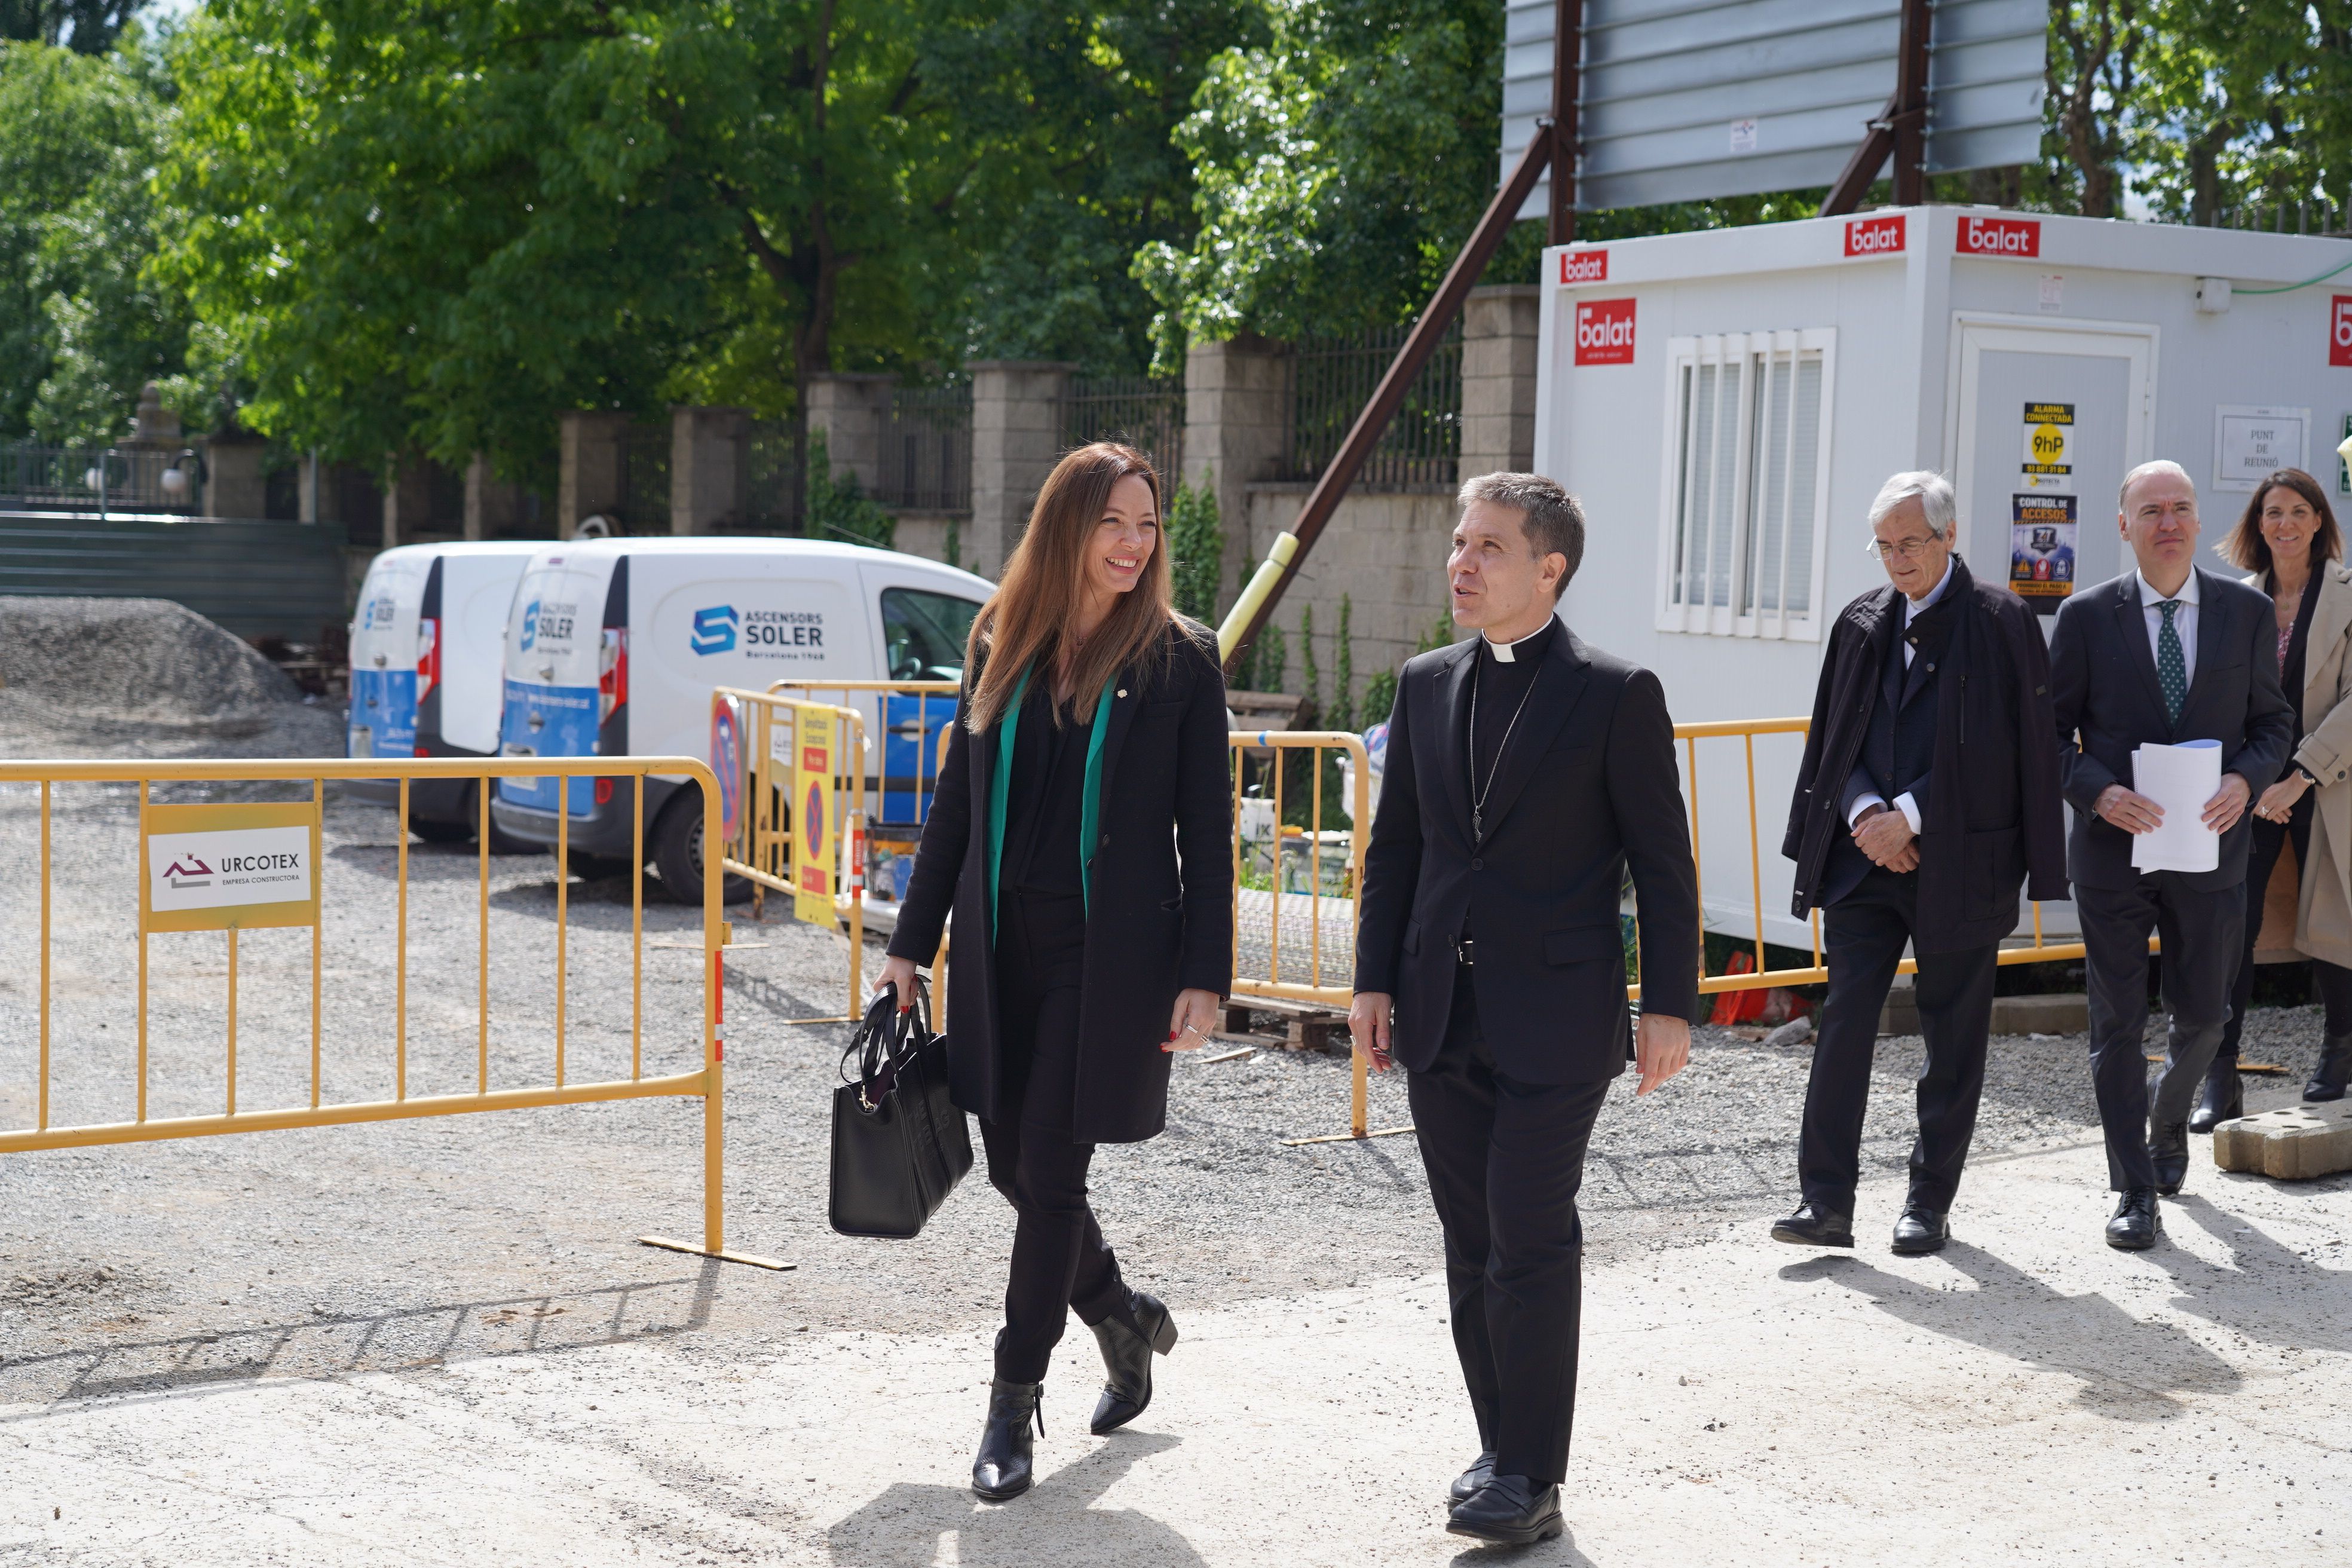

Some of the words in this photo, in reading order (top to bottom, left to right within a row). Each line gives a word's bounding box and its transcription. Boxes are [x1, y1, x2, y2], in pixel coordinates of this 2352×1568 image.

[1852, 222, 1898, 252] balat
[1968, 218, 2029, 252] balat
[1566, 253, 1602, 280] balat
[1578, 308, 1633, 348] balat
[2034, 405, 2065, 414] ALARMA
[2026, 413, 2072, 423] CONNECTADA
[2251, 430, 2274, 440] PUNT
[2256, 444, 2268, 454] DE
[2244, 457, 2278, 468] REUNIÓ
[2019, 497, 2057, 508] CONTROL
[2059, 500, 2068, 508] DE
[2022, 508, 2067, 521] ACCESOS
[746, 611, 823, 624] ASCENSORS
[539, 617, 574, 639] SOLER
[747, 626, 823, 646] SOLER
[746, 650, 798, 660] Barcelona
[222, 853, 299, 873] URCOTEX
[252, 875, 299, 884] CONSTRUCTORA
